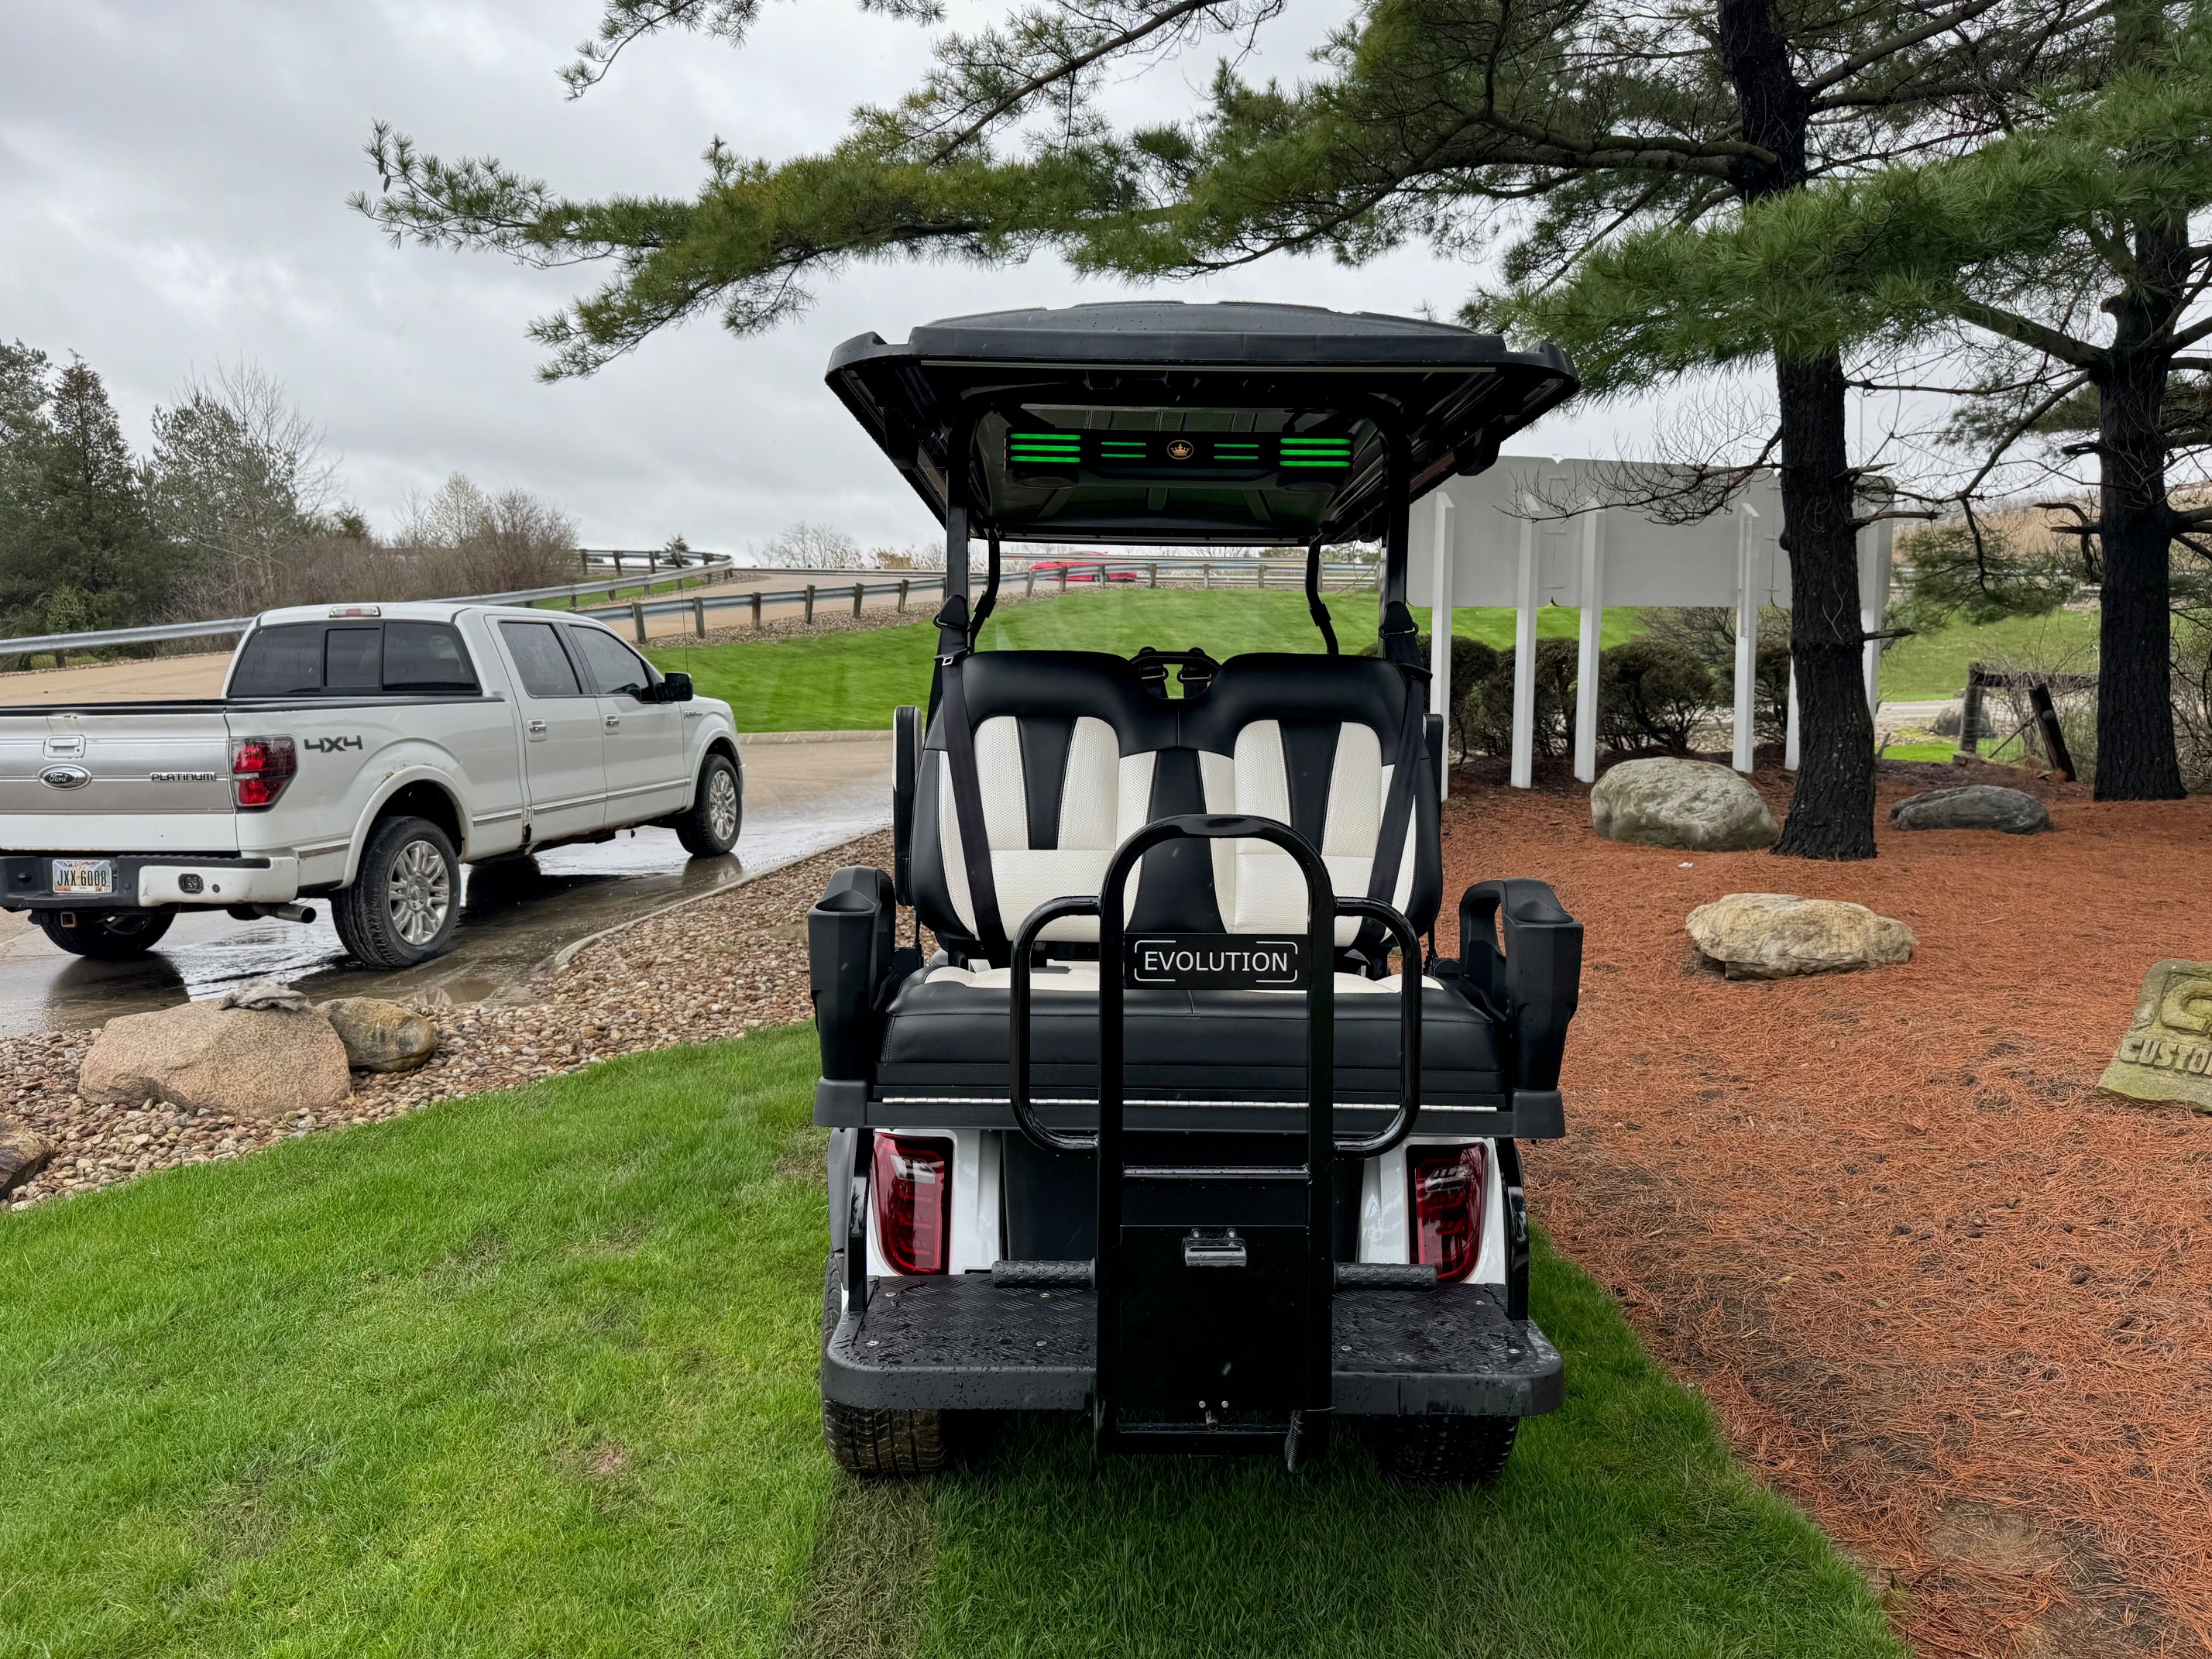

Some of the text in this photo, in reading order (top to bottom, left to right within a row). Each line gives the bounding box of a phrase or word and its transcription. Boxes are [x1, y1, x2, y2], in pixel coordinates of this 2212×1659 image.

[304, 735, 362, 753] 4X4
[49, 773, 67, 782] Ford
[152, 773, 214, 781] PLATINUM
[57, 871, 107, 886] JXX 6008
[1145, 951, 1287, 972] EVOLUTION
[2119, 1037, 2212, 1075] CUSTO
